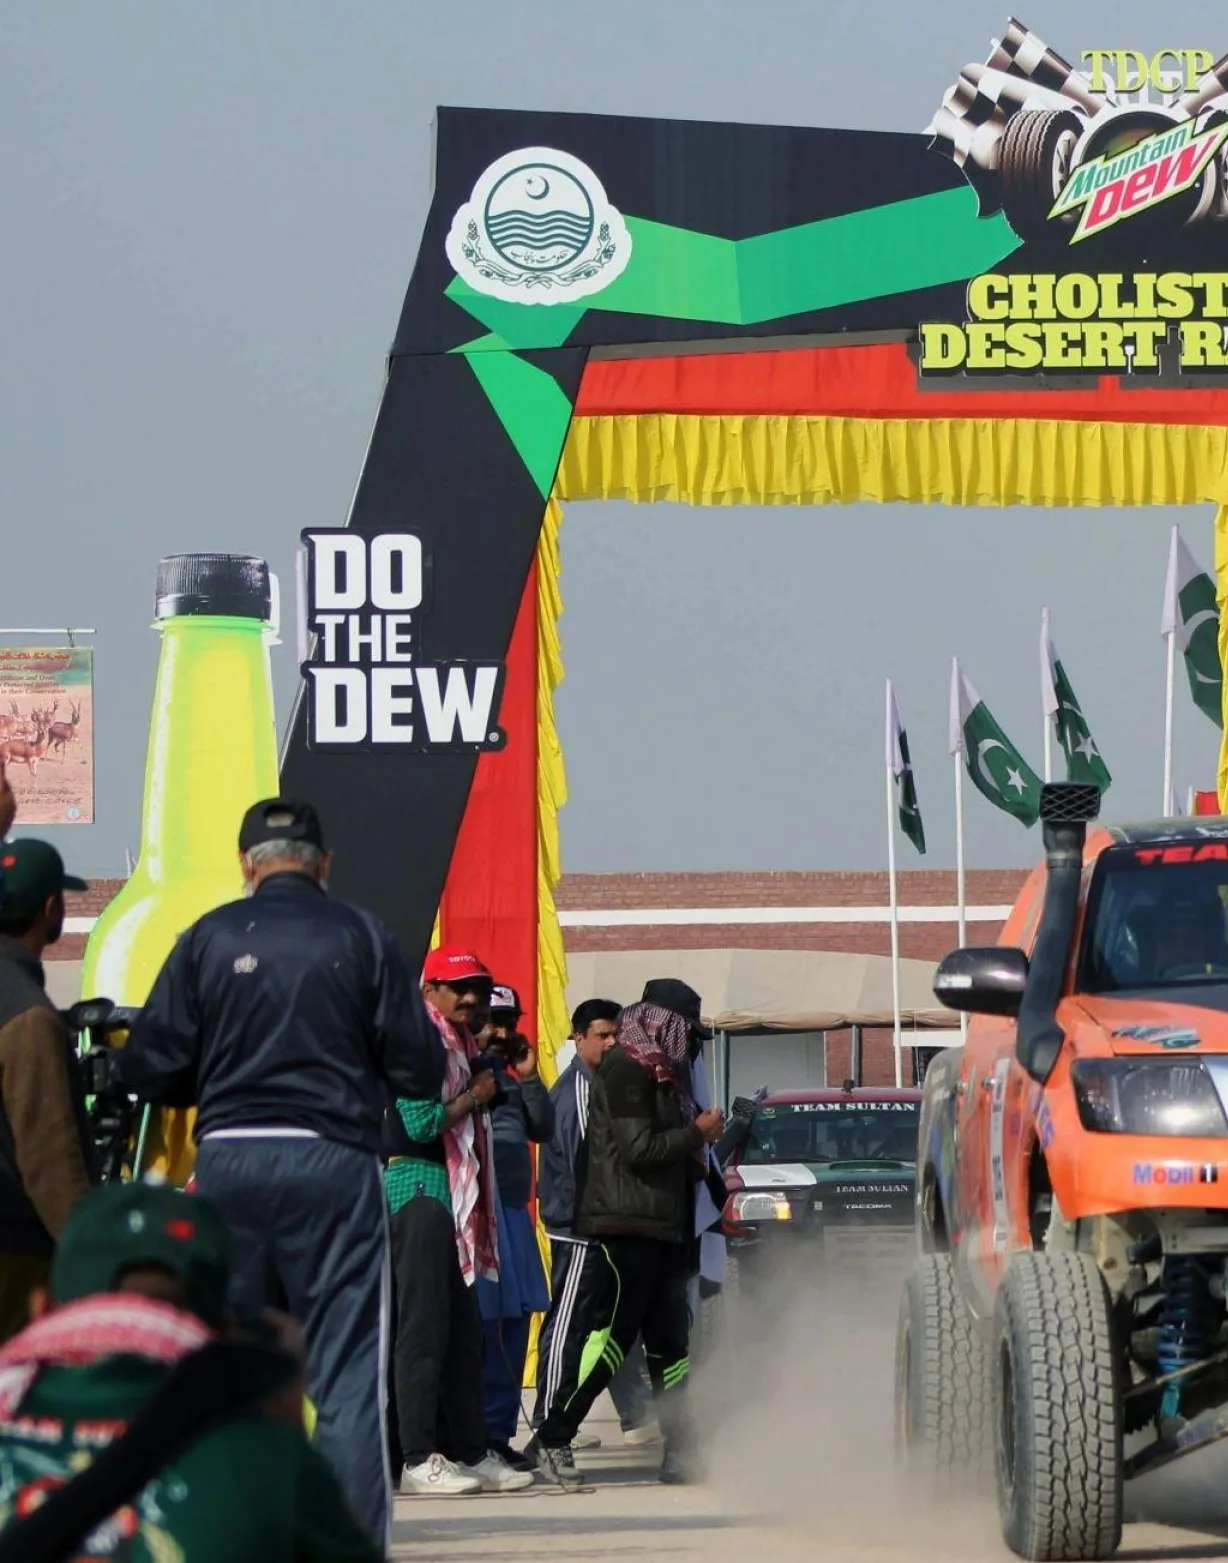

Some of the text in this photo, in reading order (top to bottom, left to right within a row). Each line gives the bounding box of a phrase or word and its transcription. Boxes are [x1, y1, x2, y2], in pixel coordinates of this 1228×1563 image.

[1081, 48, 1214, 93] TDCP
[1063, 128, 1189, 205] Mountain
[921, 321, 1167, 369] DESERT
[308, 534, 422, 610] DO
[315, 614, 412, 662] THE
[791, 1102, 915, 1113] TEAM SULTAN
